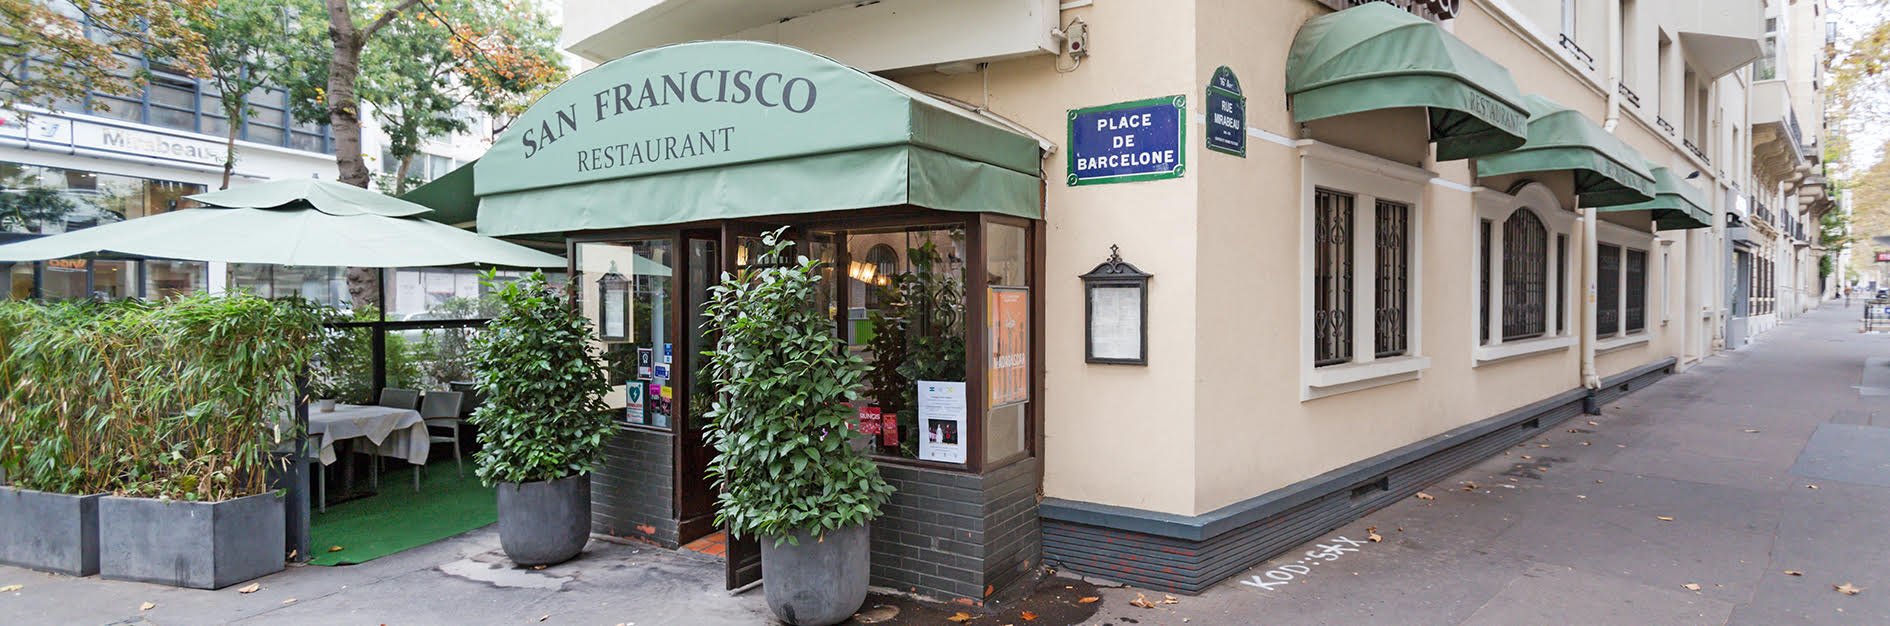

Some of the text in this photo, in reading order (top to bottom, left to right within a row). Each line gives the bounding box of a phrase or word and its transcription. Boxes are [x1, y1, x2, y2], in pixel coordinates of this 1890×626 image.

[522, 70, 818, 159] SAN FRANCISCO
[1221, 100, 1233, 114] RUE
[1470, 90, 1520, 132] RESTAURANT
[1097, 113, 1152, 132] PLACE
[1214, 112, 1240, 130] MIRABEAU
[577, 126, 735, 172] RESTAURANT
[1113, 134, 1135, 149] DE
[1077, 149, 1174, 171] BARCELONE
